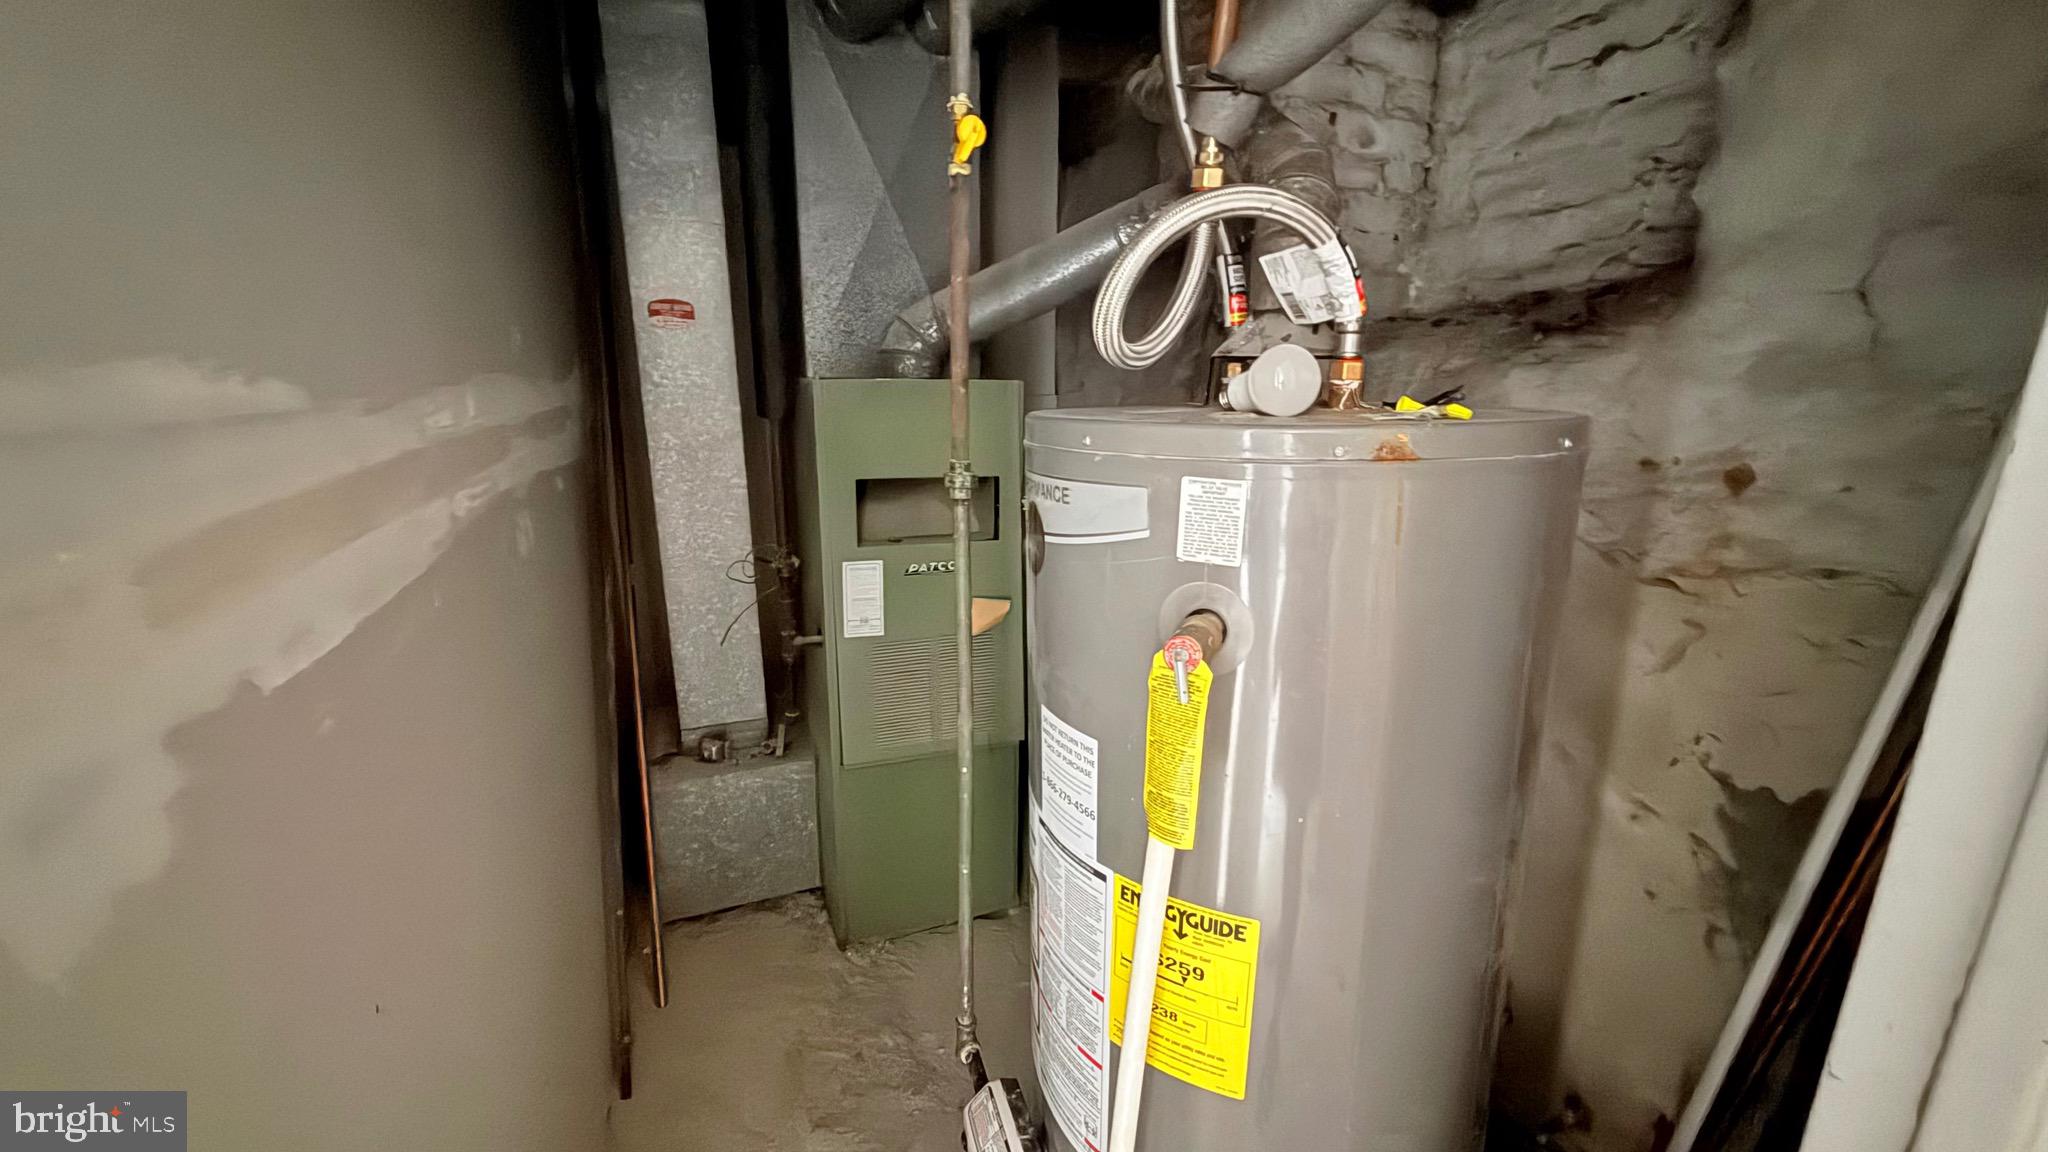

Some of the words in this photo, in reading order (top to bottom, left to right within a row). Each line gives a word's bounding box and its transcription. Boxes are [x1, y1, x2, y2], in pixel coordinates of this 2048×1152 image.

[1055, 738, 1073, 756] HEATER
[1074, 750, 1082, 761] TO
[1083, 755, 1095, 768] THE
[1058, 729, 1078, 747] RETURN
[1080, 741, 1094, 755] THIS
[1120, 884, 1247, 943] ENGYGUIDE
